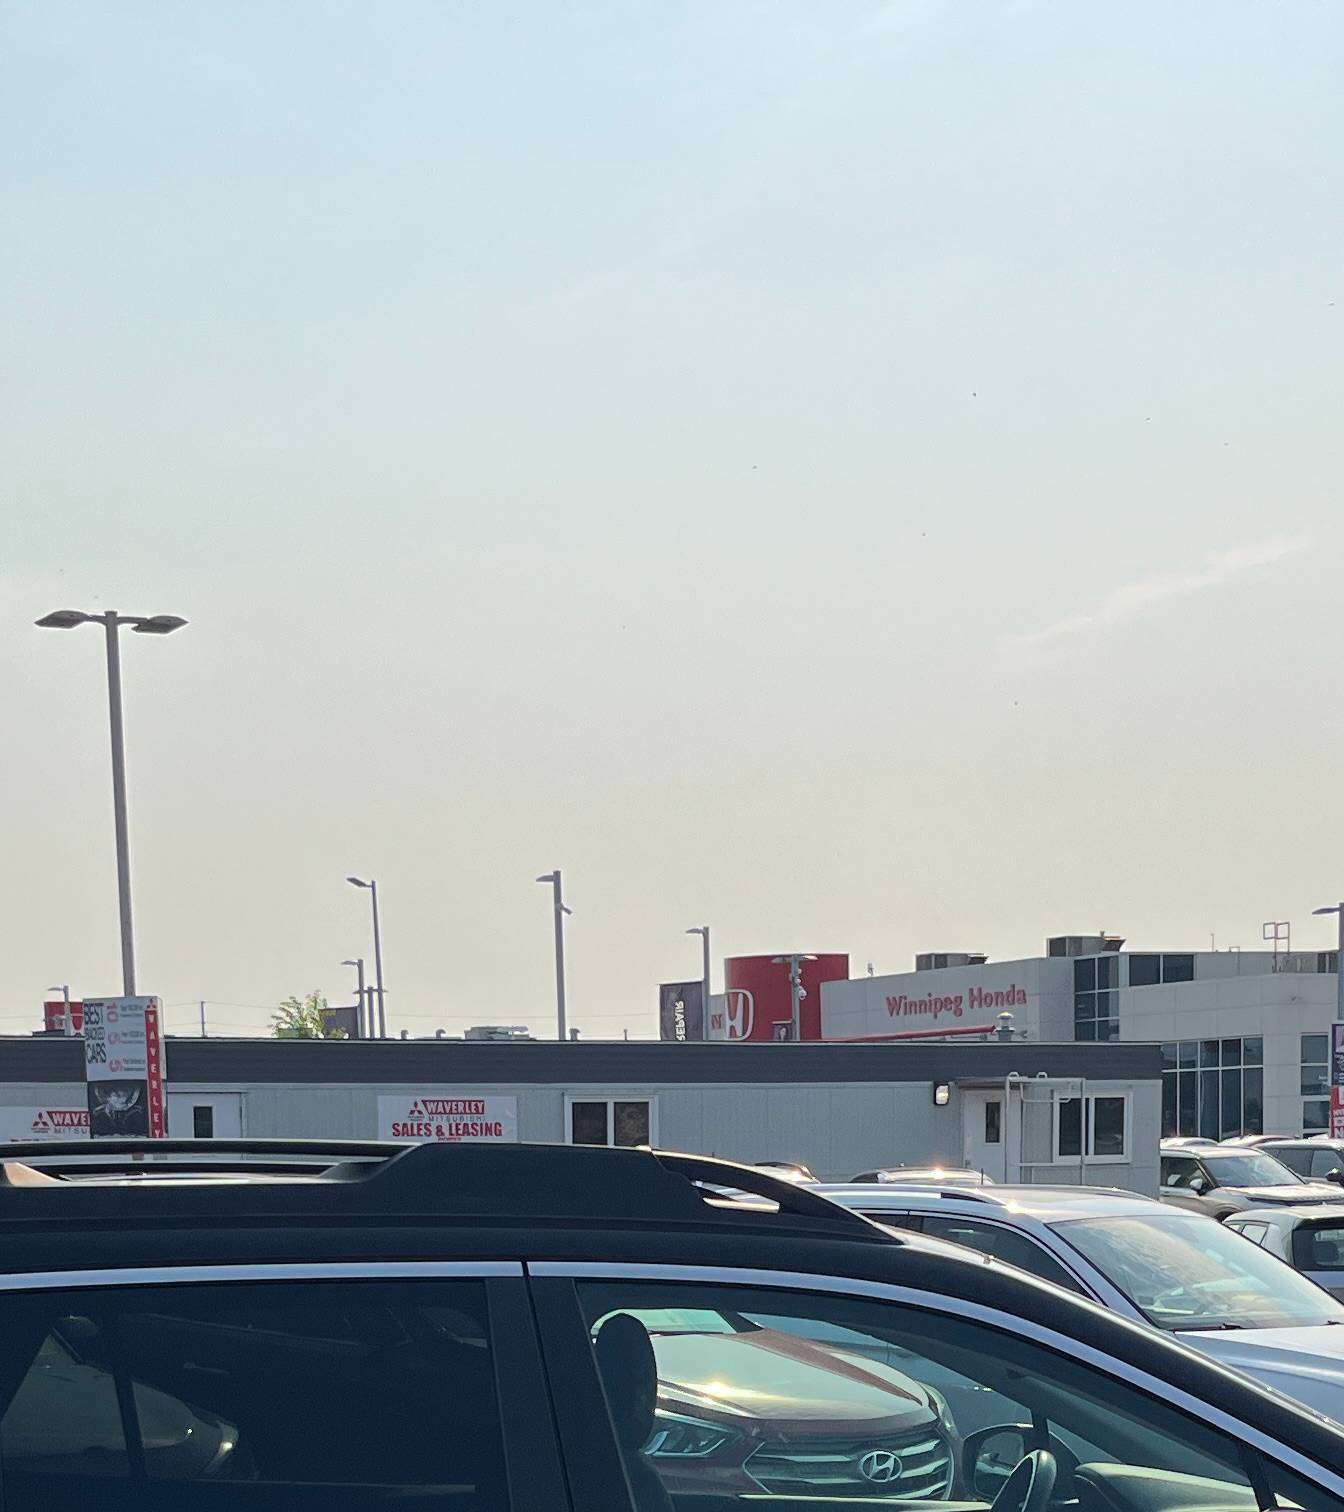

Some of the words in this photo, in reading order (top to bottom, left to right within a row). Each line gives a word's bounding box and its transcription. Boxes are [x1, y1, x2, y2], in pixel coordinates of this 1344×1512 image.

[886, 993, 963, 1019] Winnipeg
[968, 984, 1027, 1009] Honda
[84, 1003, 105, 1025] BEST
[87, 1043, 107, 1064] CARS
[147, 1014, 161, 1138] WAVERLEY
[425, 1101, 484, 1114] WAVERLEY
[52, 1111, 90, 1126] WAVE
[392, 1122, 432, 1137] SALES
[436, 1125, 445, 1137] &
[448, 1122, 503, 1137] LEASING
